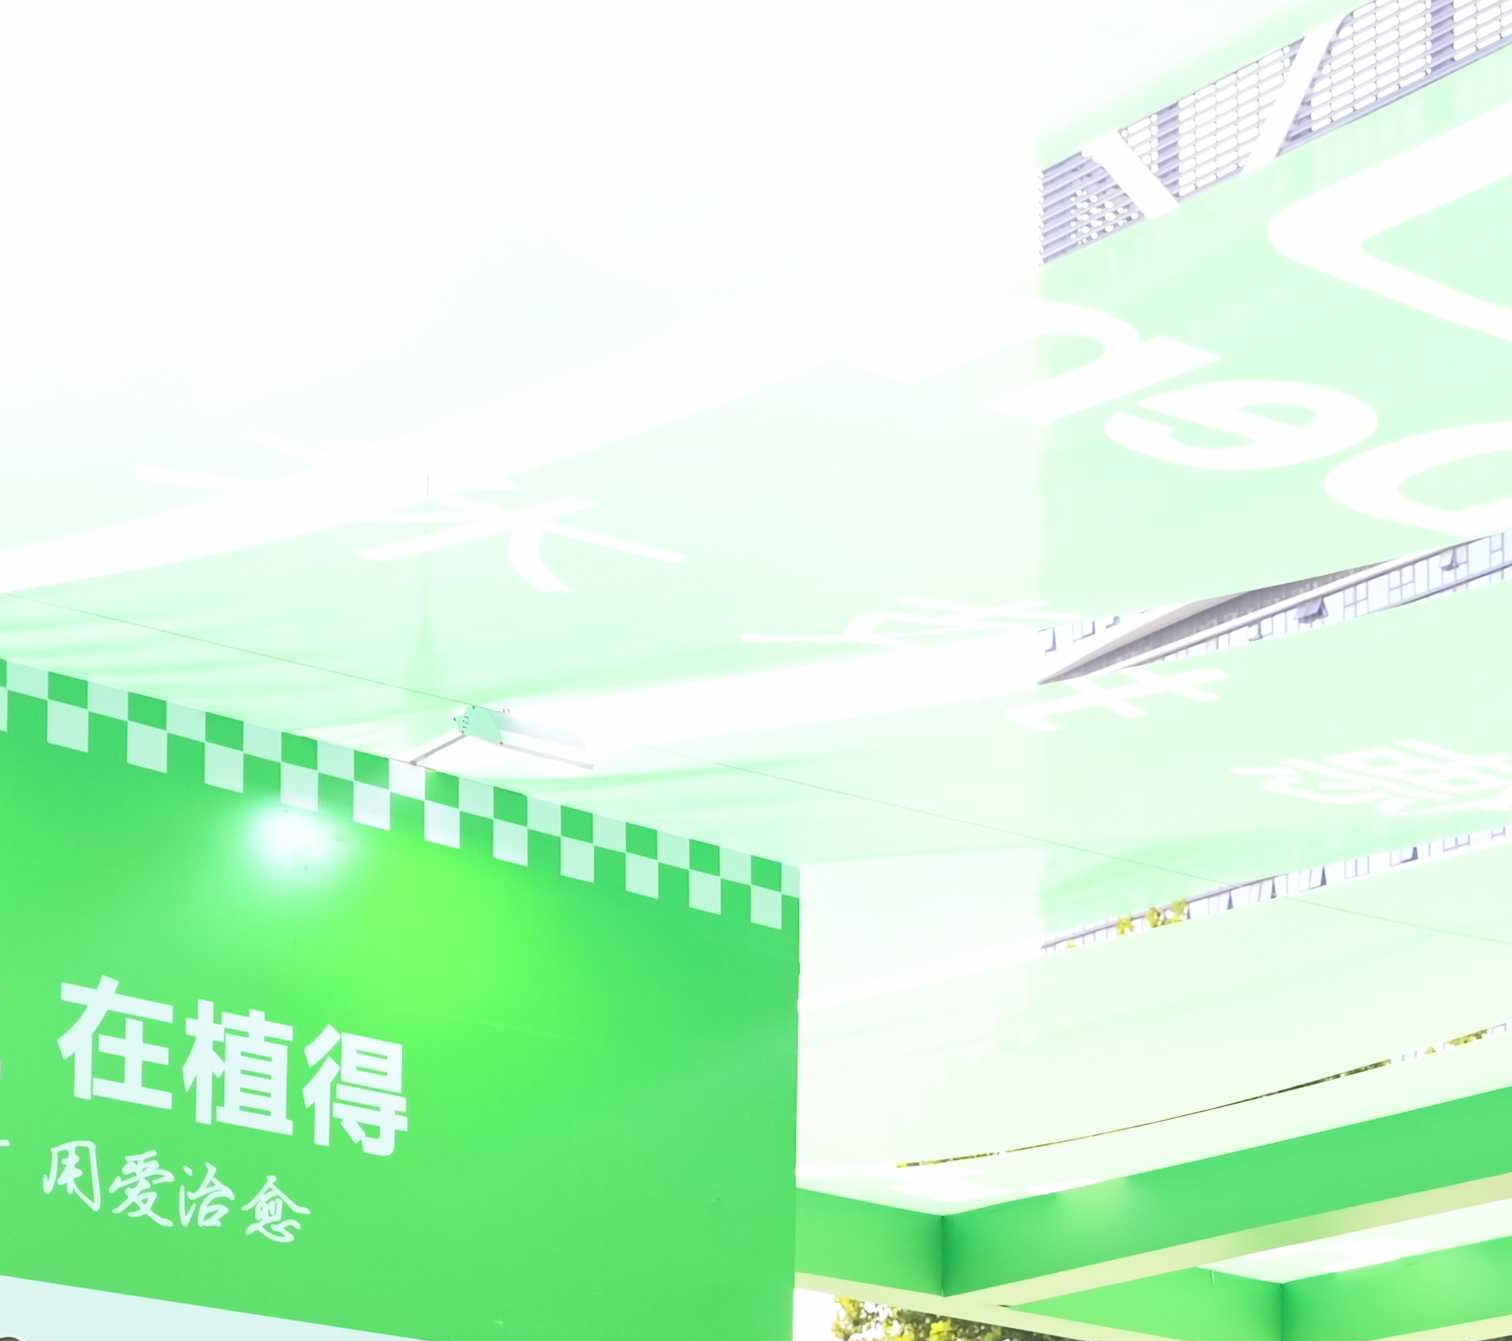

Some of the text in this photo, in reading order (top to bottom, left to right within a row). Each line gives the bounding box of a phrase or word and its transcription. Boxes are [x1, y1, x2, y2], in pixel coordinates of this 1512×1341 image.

[57, 974, 408, 1157] 在植得
[42, 1140, 311, 1244] 用爱治愈
